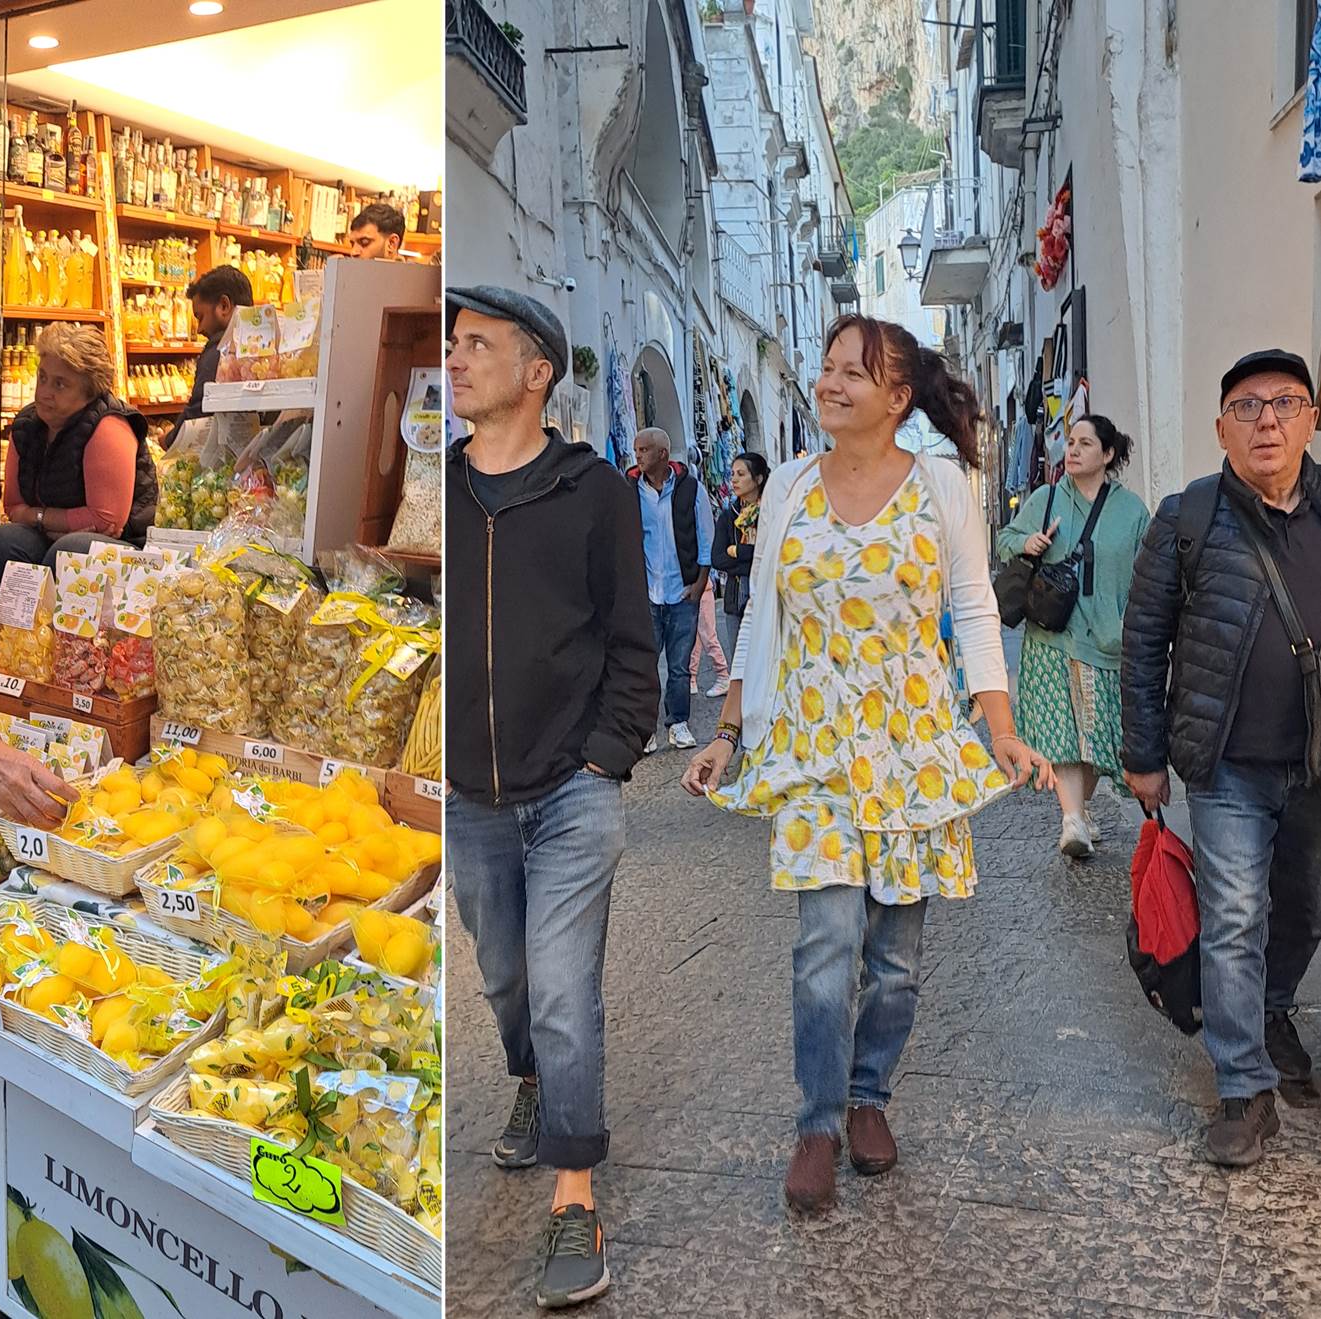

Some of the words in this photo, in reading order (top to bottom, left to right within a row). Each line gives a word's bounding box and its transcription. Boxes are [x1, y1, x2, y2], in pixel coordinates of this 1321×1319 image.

[75, 698, 91, 710] 3,50
[164, 723, 198, 740] 11,00
[251, 746, 277, 760] 6,00
[258, 765, 271, 776] dei
[272, 767, 303, 783] BARBI
[21, 834, 44, 858] 2,0
[161, 892, 195, 913] 2,50
[256, 1145, 287, 1164] Euro
[283, 1164, 301, 1194] 2
[44, 1154, 284, 1319] LIMONCELLO
